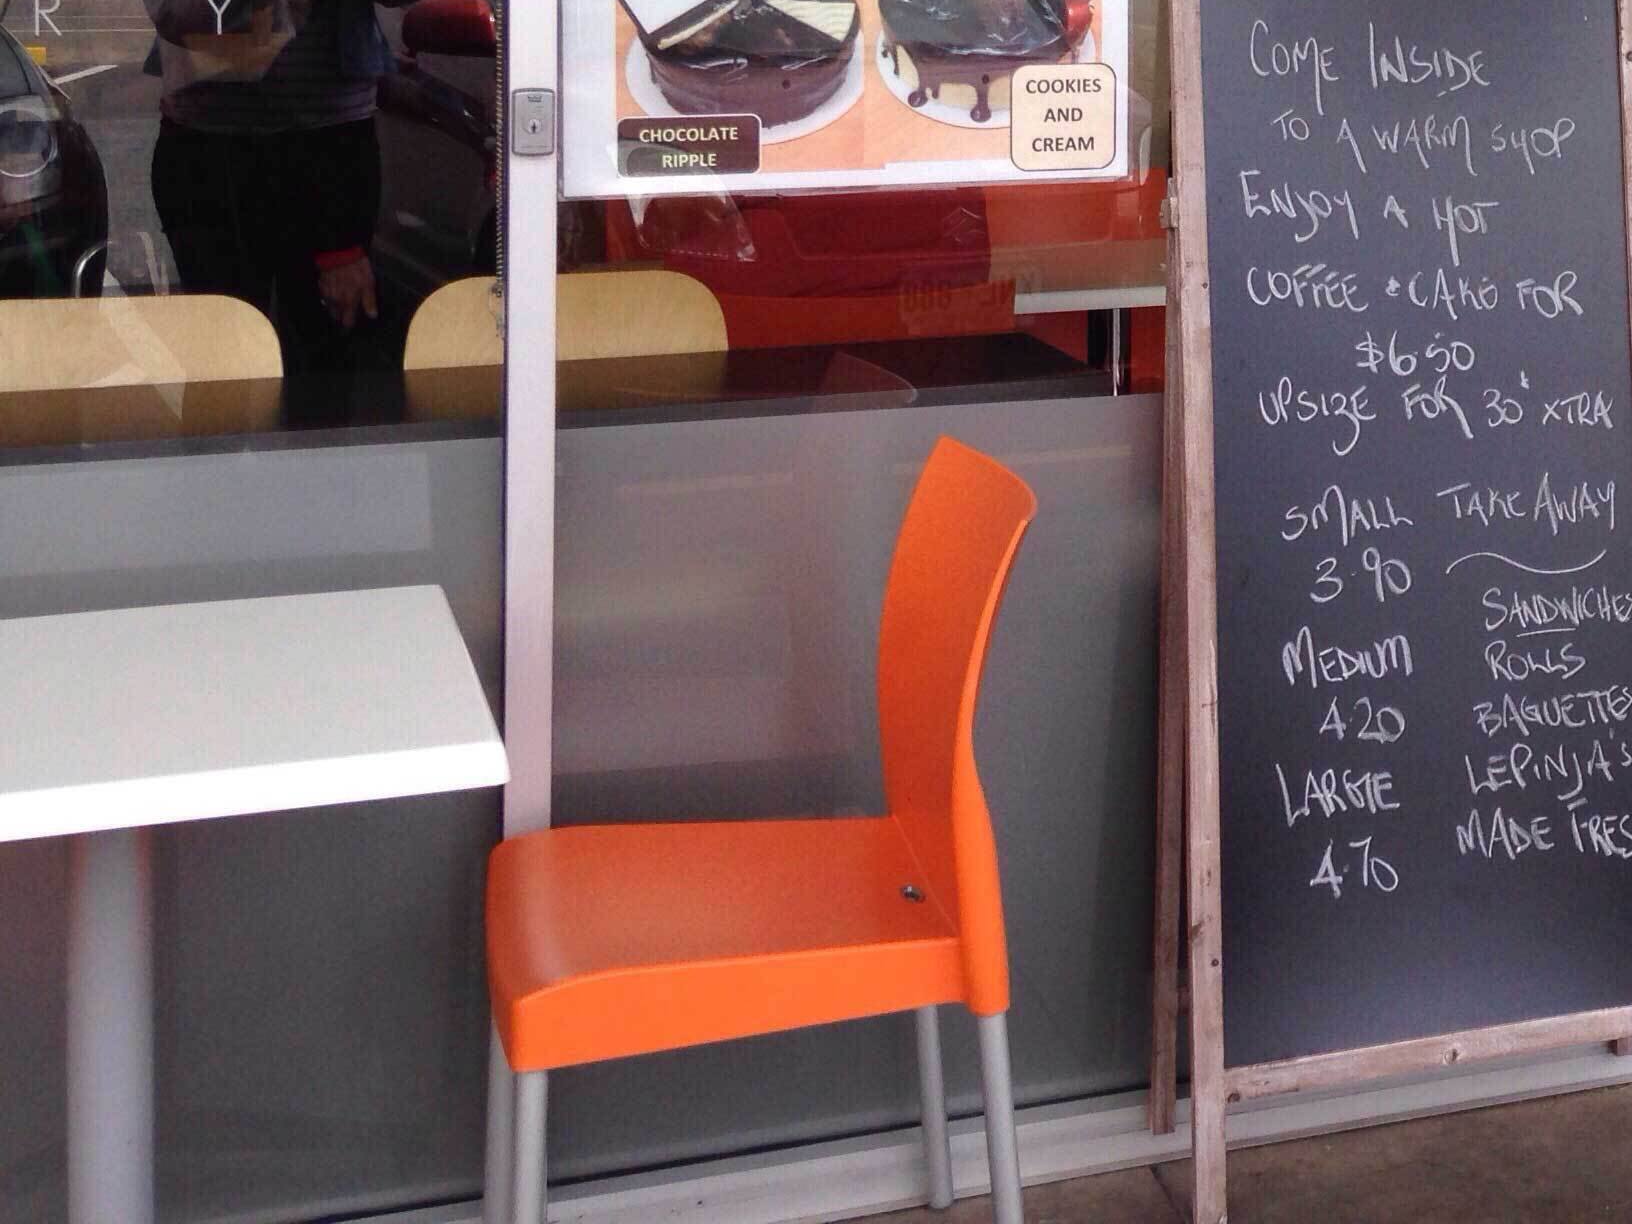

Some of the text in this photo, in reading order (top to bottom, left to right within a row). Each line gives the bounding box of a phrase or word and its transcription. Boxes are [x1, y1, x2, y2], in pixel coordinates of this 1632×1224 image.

[1024, 77, 1102, 96] COOKIES
[1250, 20, 1490, 115] COME INSIDE
[638, 125, 740, 144] CHOCOLATE
[1031, 134, 1096, 153] CREAM
[1043, 105, 1084, 124] AND
[1271, 109, 1576, 175] TO A WARM SHOP
[661, 151, 718, 169] RIPPLE
[1239, 170, 1500, 266] ENJOY A HOT
[1247, 264, 1369, 312] COFFEE
[1409, 268, 1498, 320] CAKE
[1517, 271, 1584, 319] FOR
[1259, 377, 1377, 456] UPSIZE
[1402, 375, 1473, 439] FOR
[1542, 395, 1614, 430] XTRA
[1281, 485, 1414, 547] SMALL
[1437, 472, 1616, 536] TAKE AWAY
[1282, 626, 1414, 688] MEDIUM
[1484, 640, 1586, 681] ROLLS
[1275, 763, 1401, 827] LARGE
[1456, 807, 1554, 860] MADE
